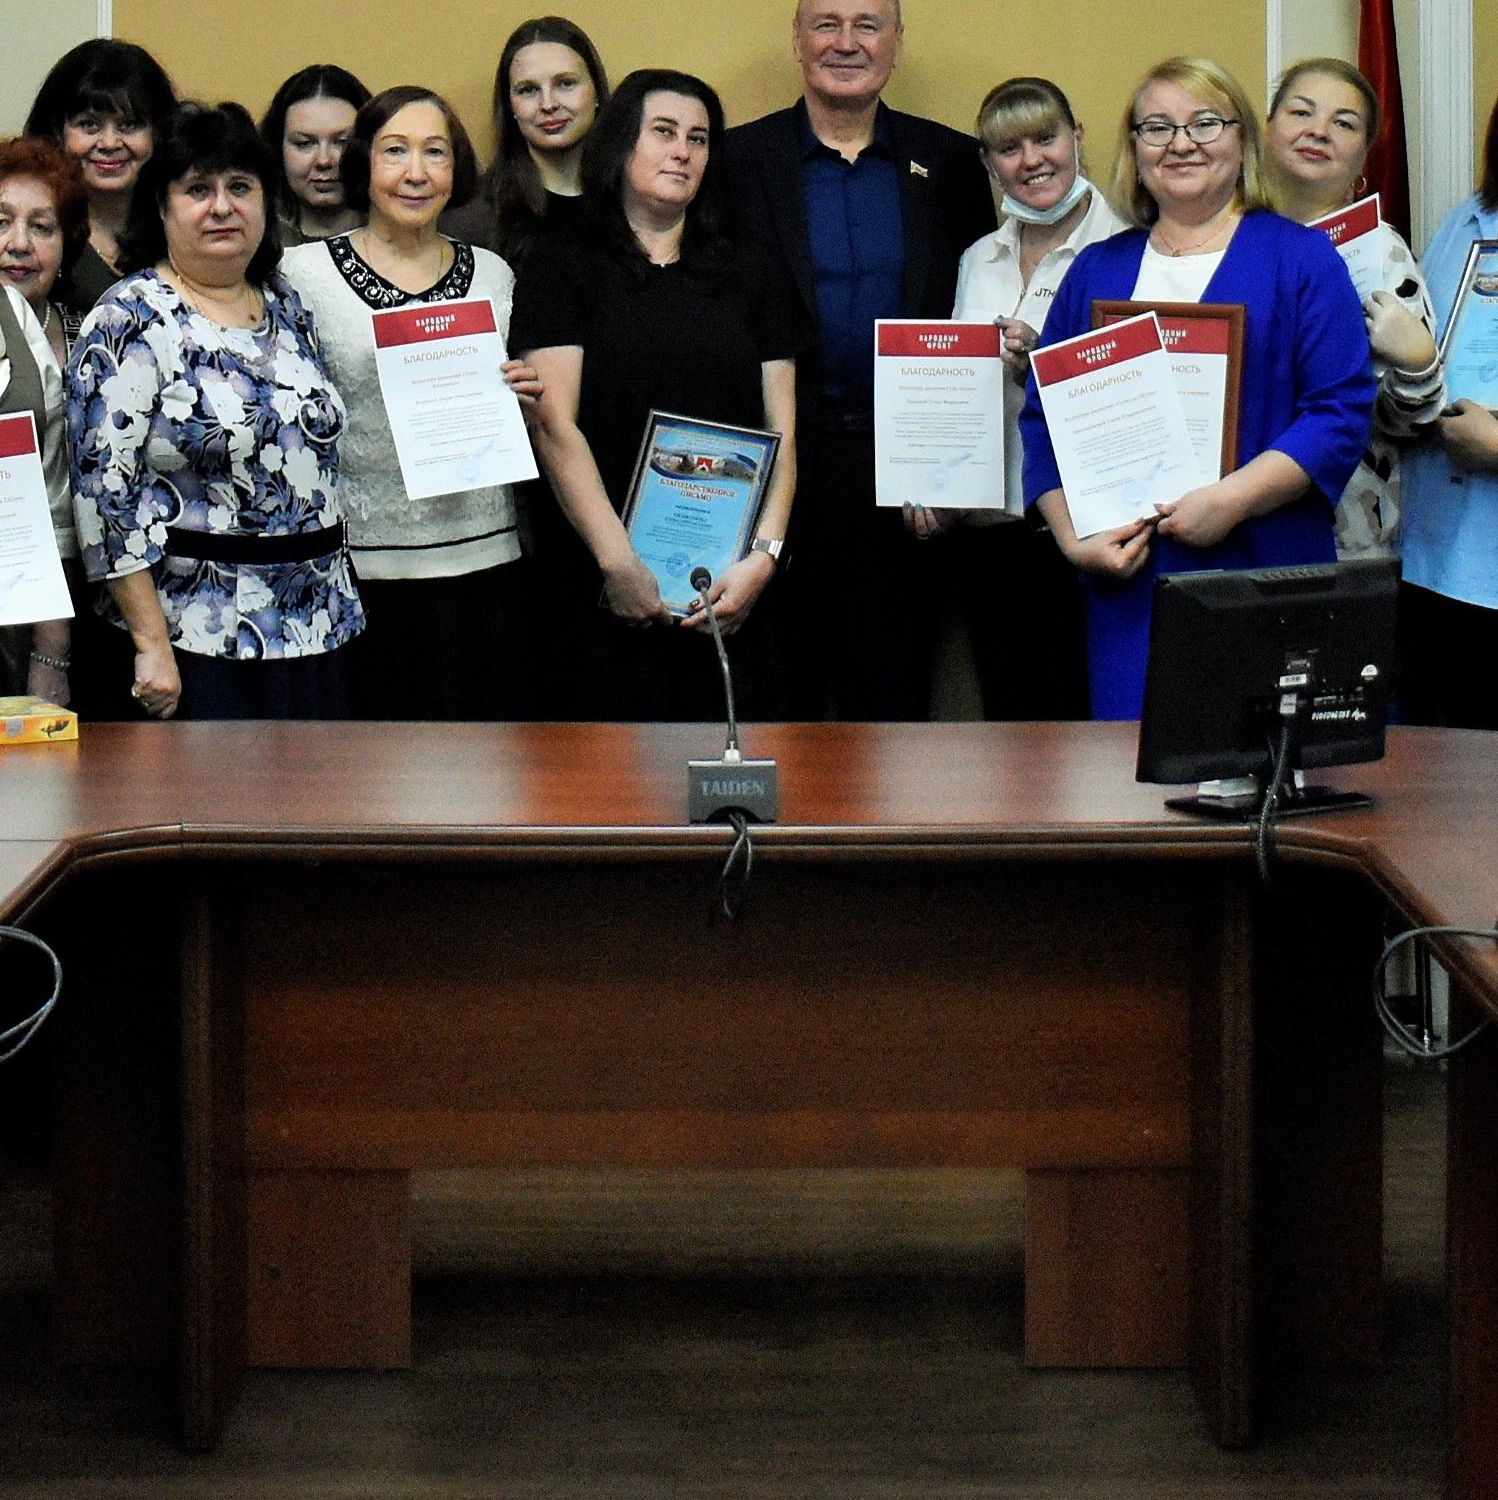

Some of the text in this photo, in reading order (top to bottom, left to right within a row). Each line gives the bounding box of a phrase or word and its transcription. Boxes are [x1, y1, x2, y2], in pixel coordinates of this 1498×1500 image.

[1033, 287, 1056, 298] UTH
[403, 346, 479, 364] БЛАГОДАРНОСТЬ
[1076, 339, 1117, 360] НАРОДНЫЙ
[1086, 352, 1111, 364] ФРОНТ
[901, 368, 975, 377] БЛАГОДАРНОСТЬ
[1171, 364, 1202, 374] НОСТЬ
[1068, 369, 1142, 399] БЛАГОДАРНОСТЬ
[701, 780, 765, 796] TAIDEN
